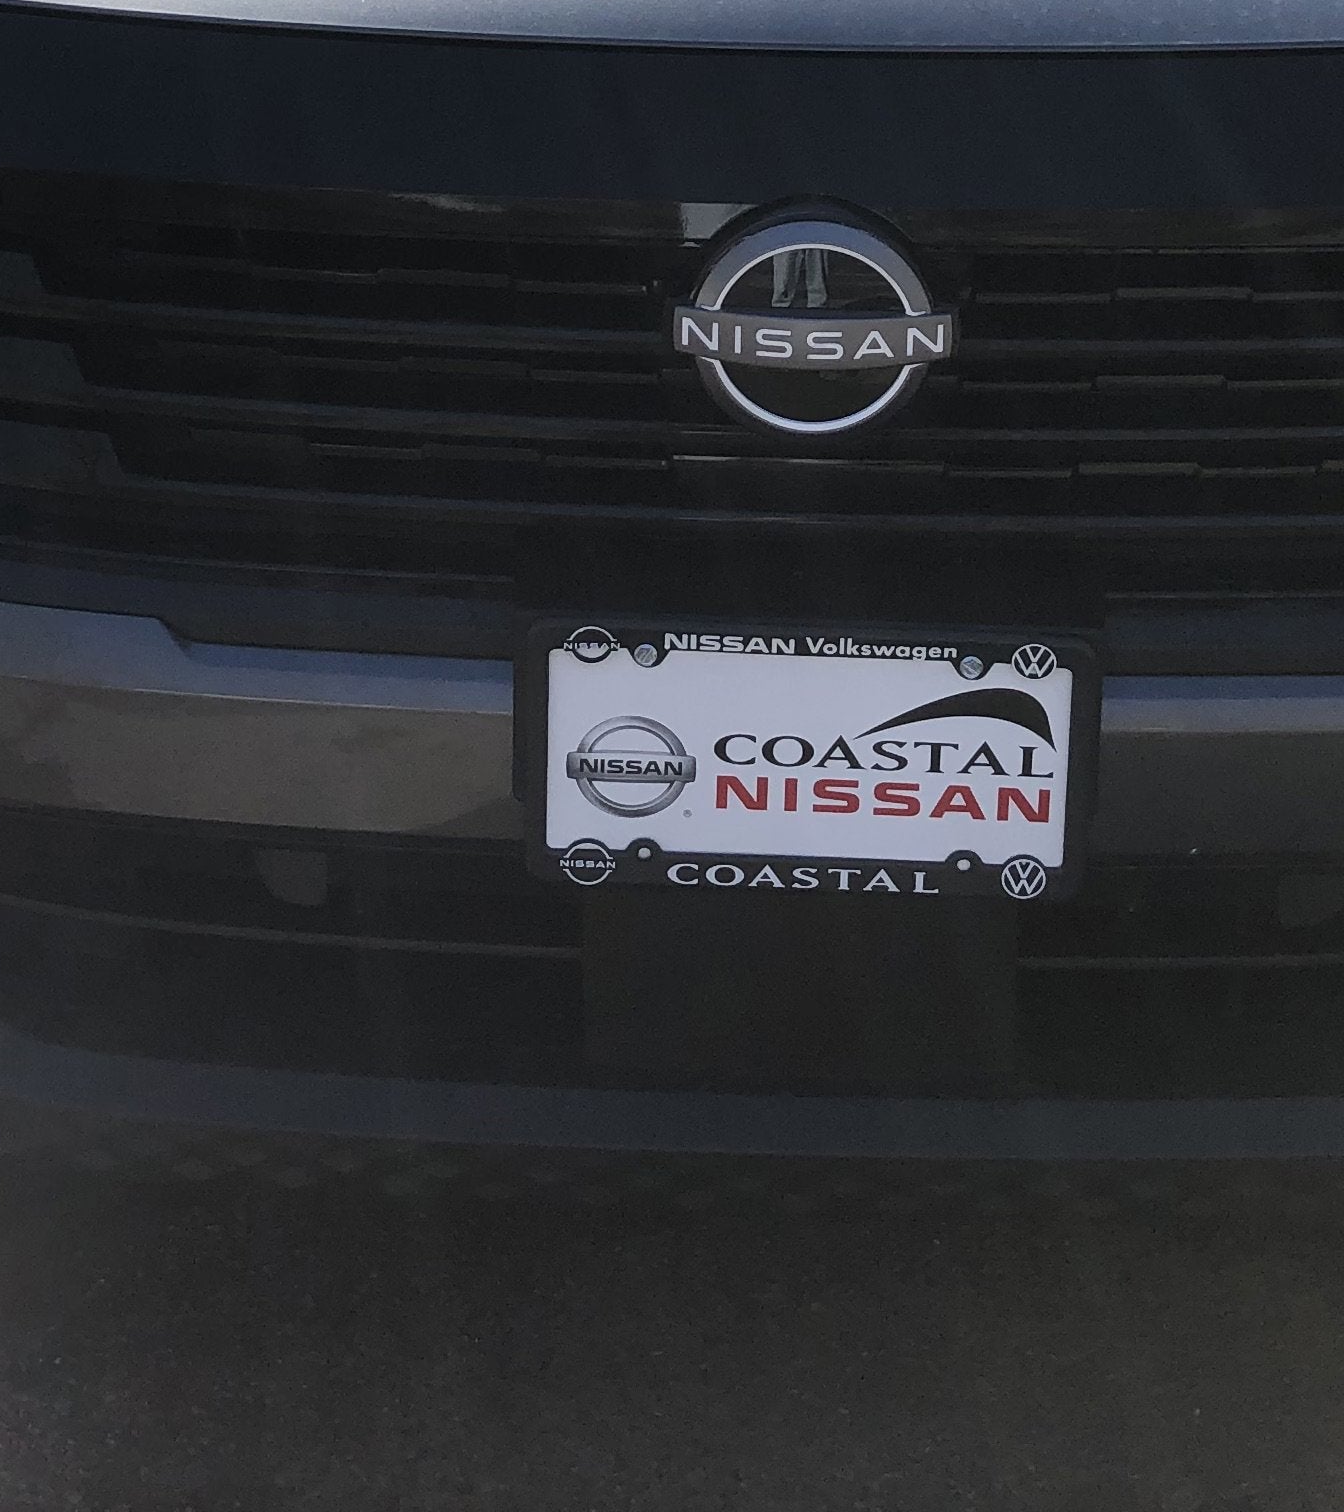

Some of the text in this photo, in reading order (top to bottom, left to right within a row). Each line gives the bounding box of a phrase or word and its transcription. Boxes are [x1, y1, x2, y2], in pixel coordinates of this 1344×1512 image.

[680, 316, 945, 360] NISSAN
[563, 642, 621, 651] NISSAN
[664, 632, 958, 661] NISSAN Volkswagen
[578, 756, 684, 778] NISSAN
[712, 733, 1055, 779] COASTAL
[714, 774, 1051, 824] NISSAN
[559, 858, 616, 870] NISSAN
[666, 862, 940, 895] COASTAL
